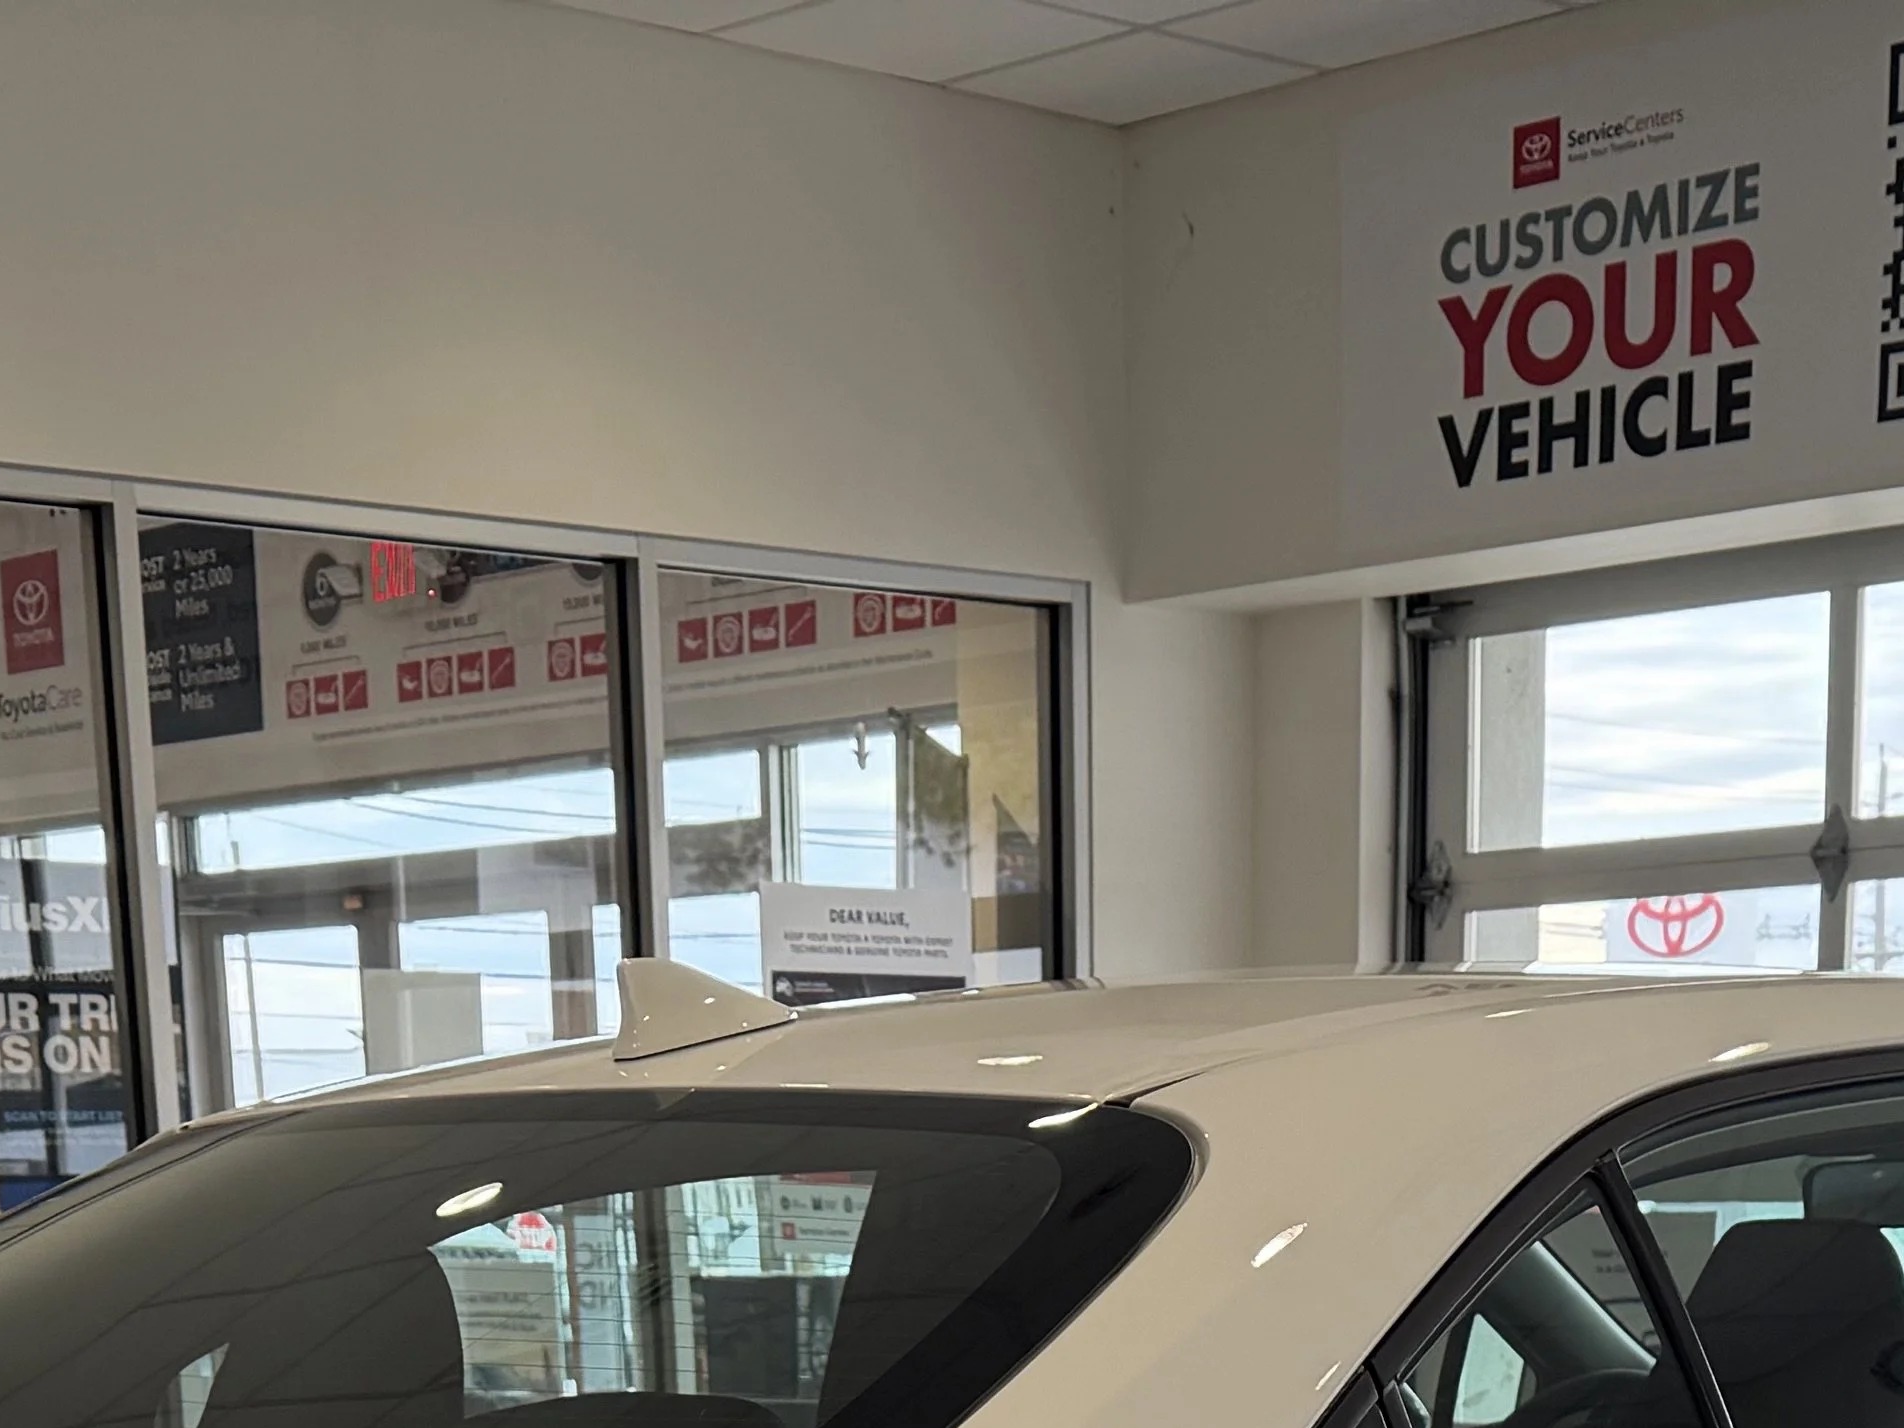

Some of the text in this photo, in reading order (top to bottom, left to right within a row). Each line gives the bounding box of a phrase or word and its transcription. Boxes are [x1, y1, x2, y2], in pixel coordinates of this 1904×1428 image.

[1567, 108, 1684, 148] ServiceCenters
[1440, 162, 1761, 284] CUSTOMIZE
[1438, 238, 1761, 398] YOUR
[1438, 359, 1753, 489] VEHICLE
[829, 908, 909, 929] DEAR VALUE,
[43, 1034, 111, 1074] ON
